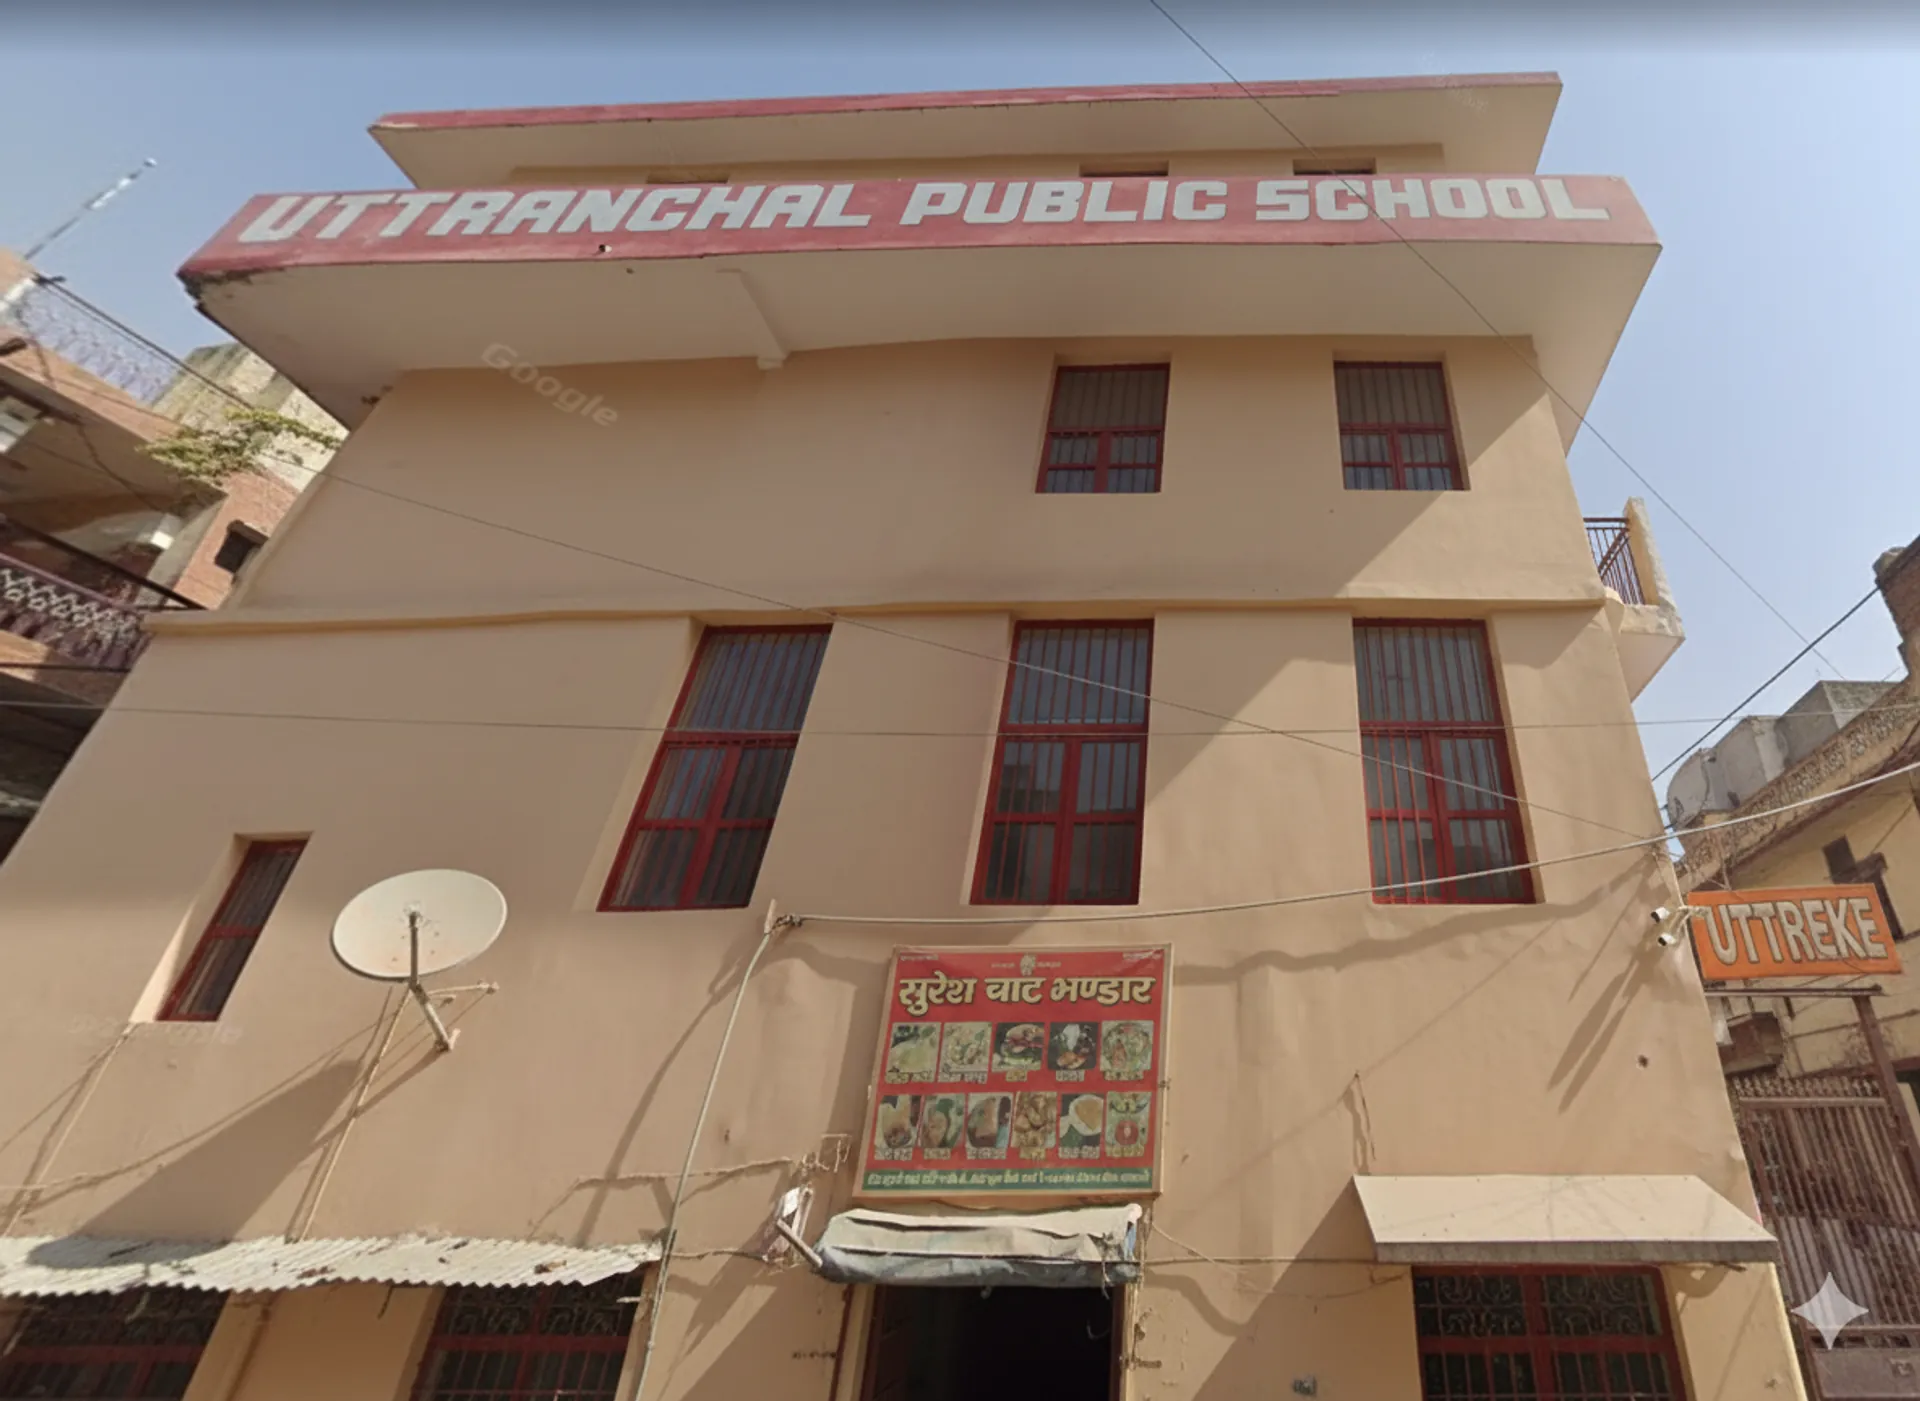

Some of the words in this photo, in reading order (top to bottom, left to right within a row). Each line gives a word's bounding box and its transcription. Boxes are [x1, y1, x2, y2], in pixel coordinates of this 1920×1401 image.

[238, 184, 872, 242] UTTRANCHAL
[900, 180, 1228, 225] PUBLIC
[1256, 178, 1610, 221] SCHOOL
[1703, 897, 1889, 966] UTTREKE
[899, 970, 978, 1016] सुरेश
[984, 977, 1047, 1004] चाट
[1051, 977, 1156, 1006] भण्डार
